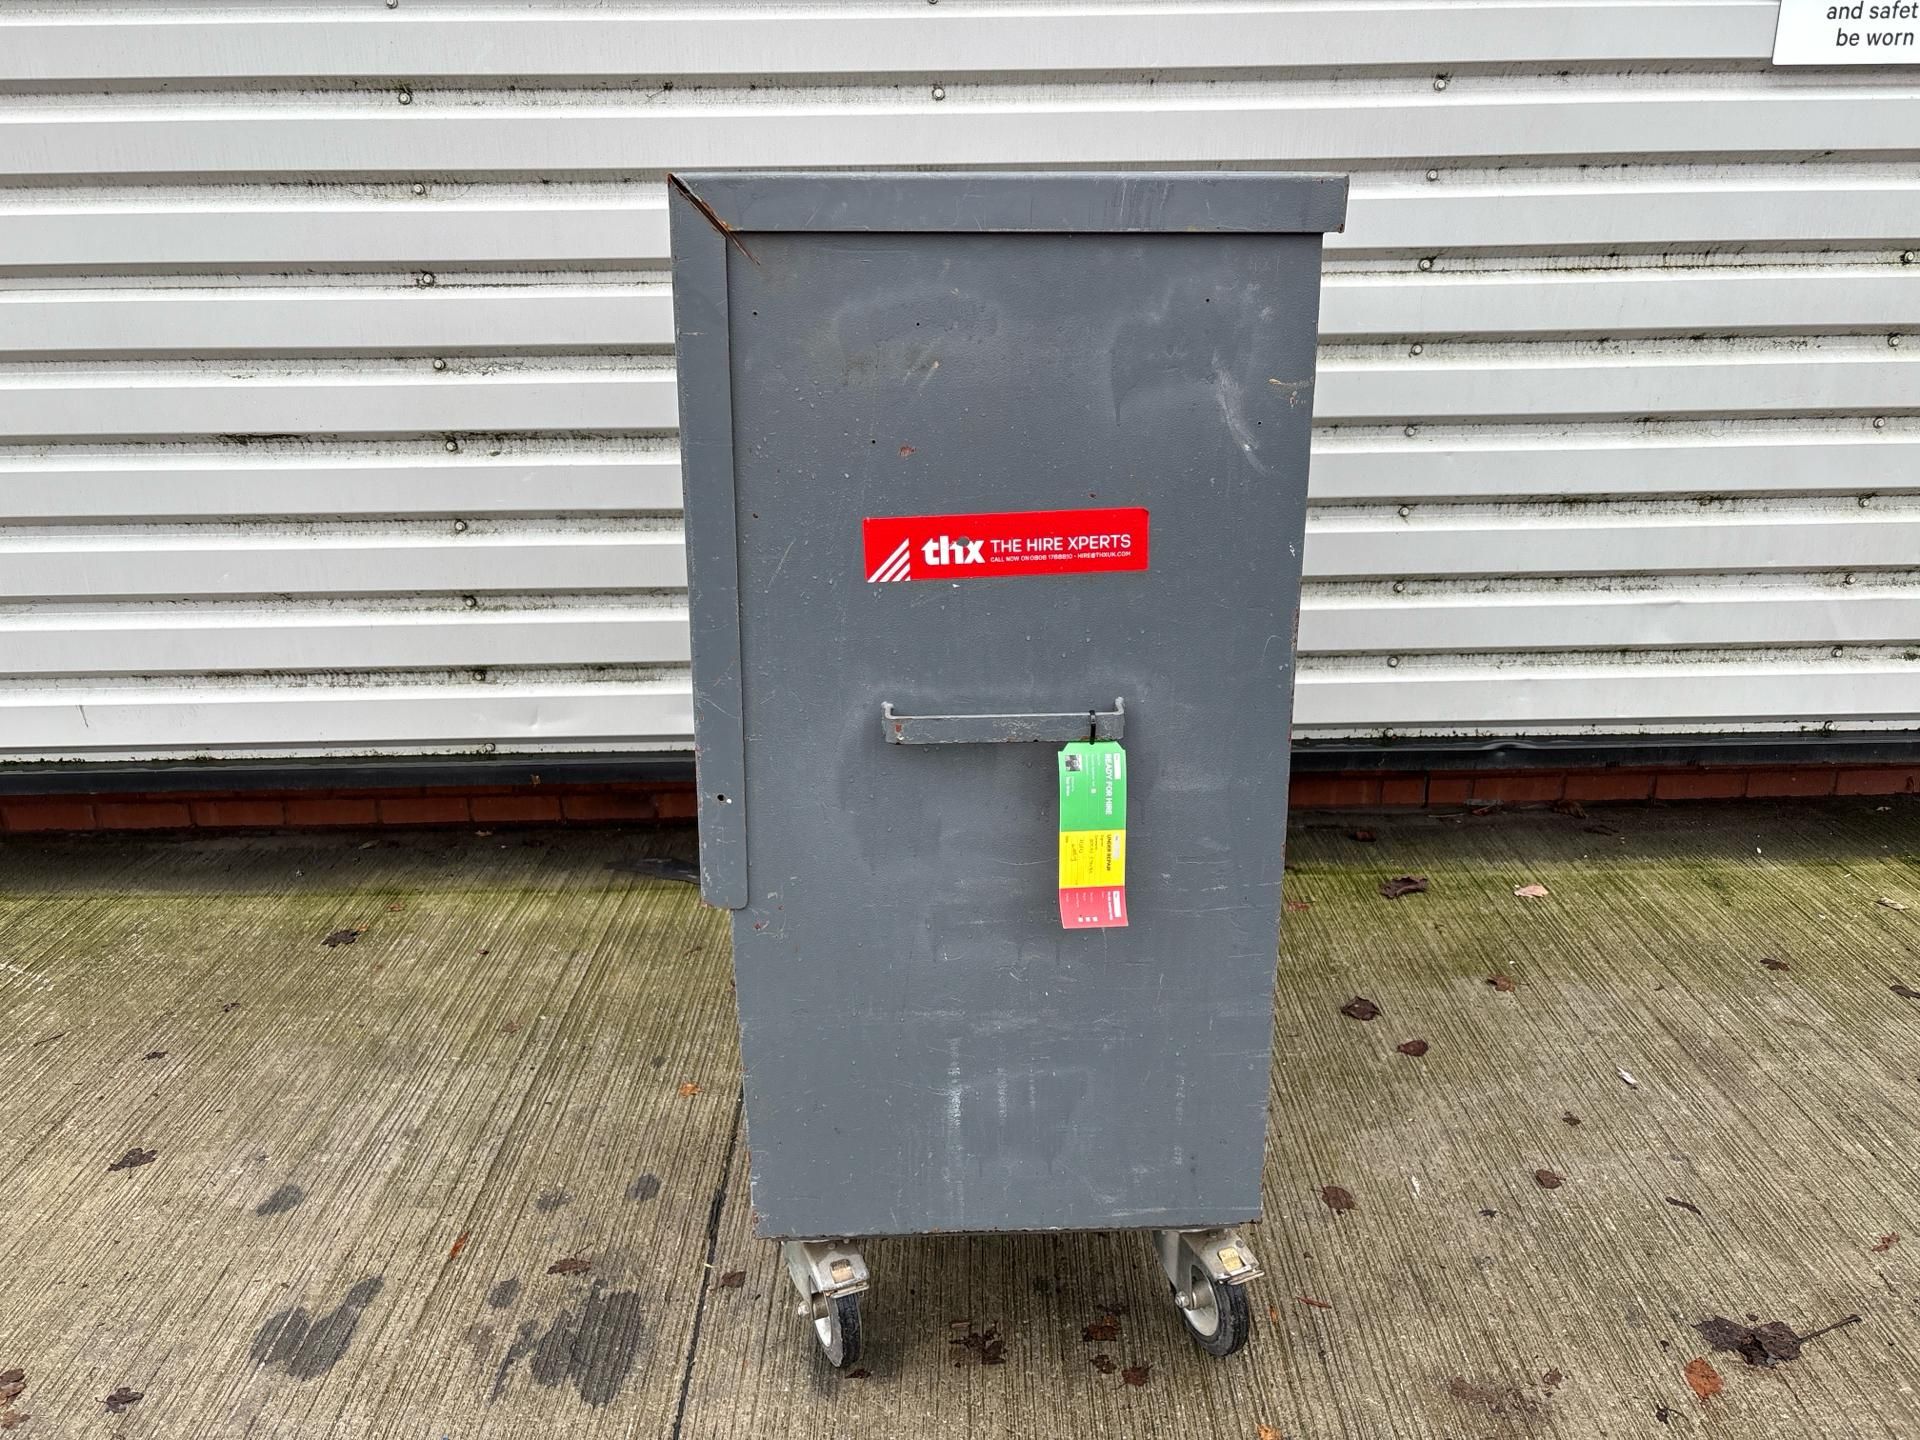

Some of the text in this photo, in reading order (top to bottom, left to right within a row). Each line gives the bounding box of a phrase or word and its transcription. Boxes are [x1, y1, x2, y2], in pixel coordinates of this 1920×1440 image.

[1827, 0, 1864, 19] and
[1836, 27, 1914, 46] be worn
[921, 535, 985, 566] thx
[990, 534, 1131, 553] THE HIRE XPERTS
[1021, 554, 1030, 562] ON
[1104, 753, 1113, 816] READY FOR HIRE
